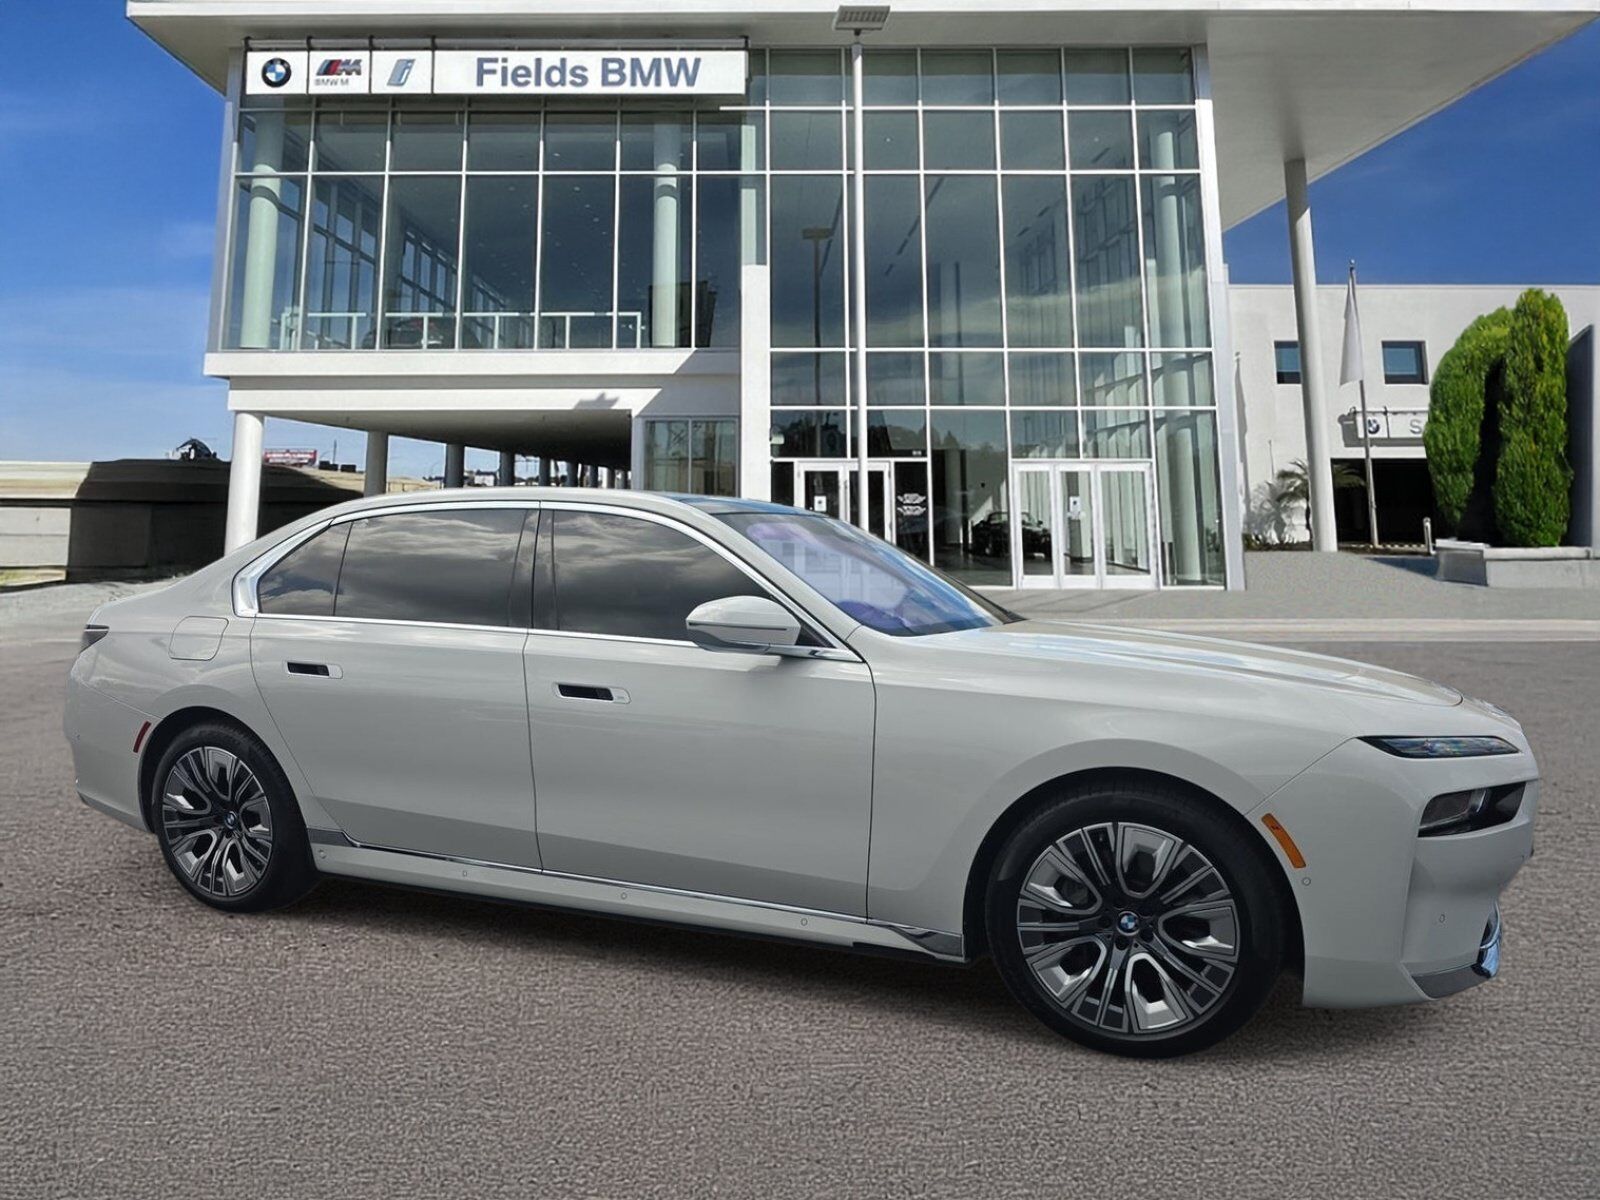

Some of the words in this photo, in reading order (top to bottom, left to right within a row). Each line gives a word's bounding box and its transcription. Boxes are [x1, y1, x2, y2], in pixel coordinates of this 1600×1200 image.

[476, 57, 589, 87] Fields
[601, 57, 702, 87] BMW
[315, 78, 339, 86] BMW
